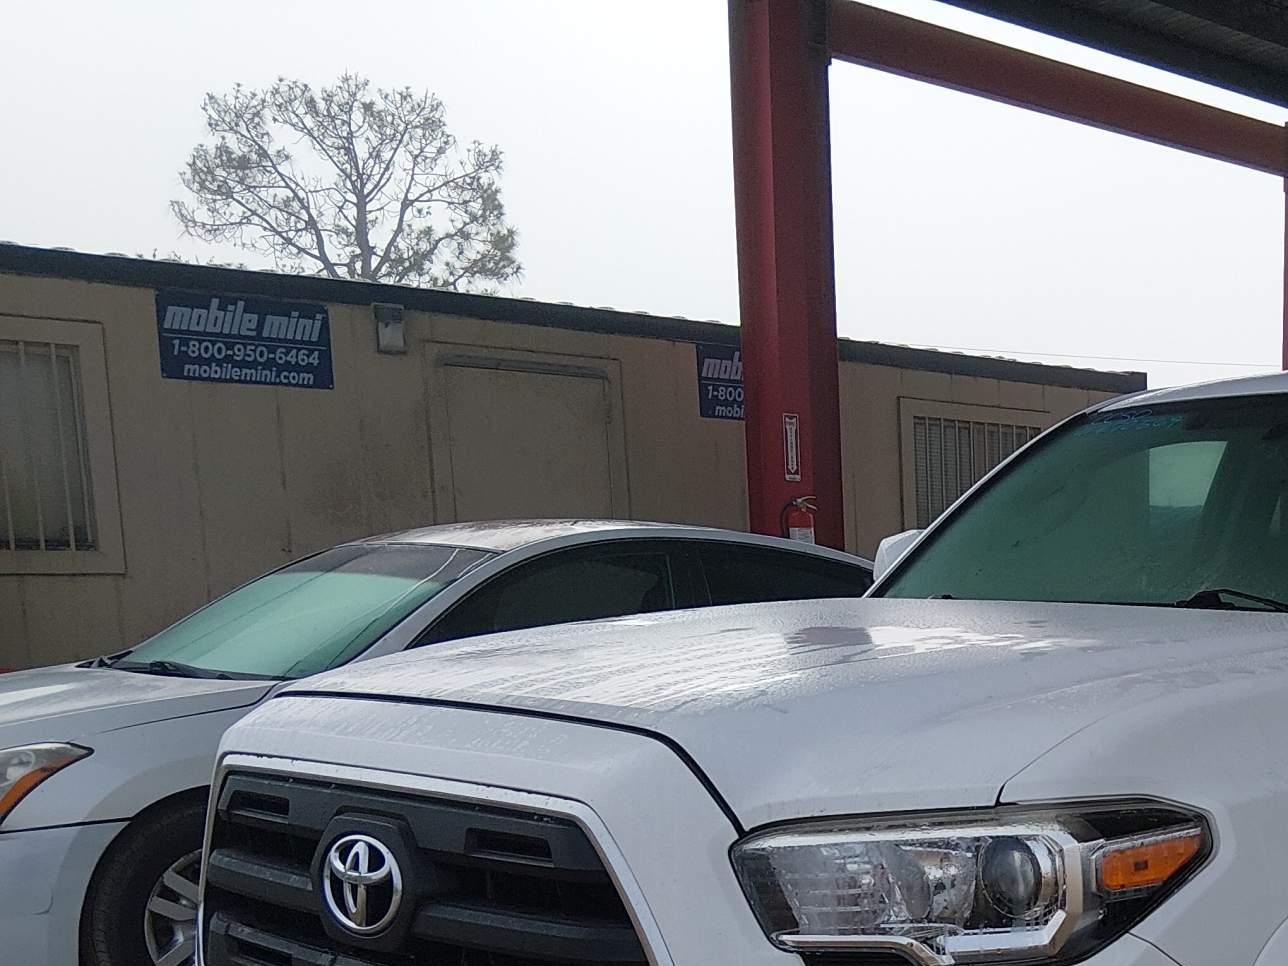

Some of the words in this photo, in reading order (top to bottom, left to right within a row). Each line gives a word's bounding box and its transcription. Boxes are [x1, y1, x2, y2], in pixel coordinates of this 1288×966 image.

[163, 298, 258, 335] mobile
[262, 311, 322, 341] mini
[172, 339, 319, 366] 1-800-950-6464
[701, 351, 743, 380] mob
[183, 363, 314, 384] mobilemini.com
